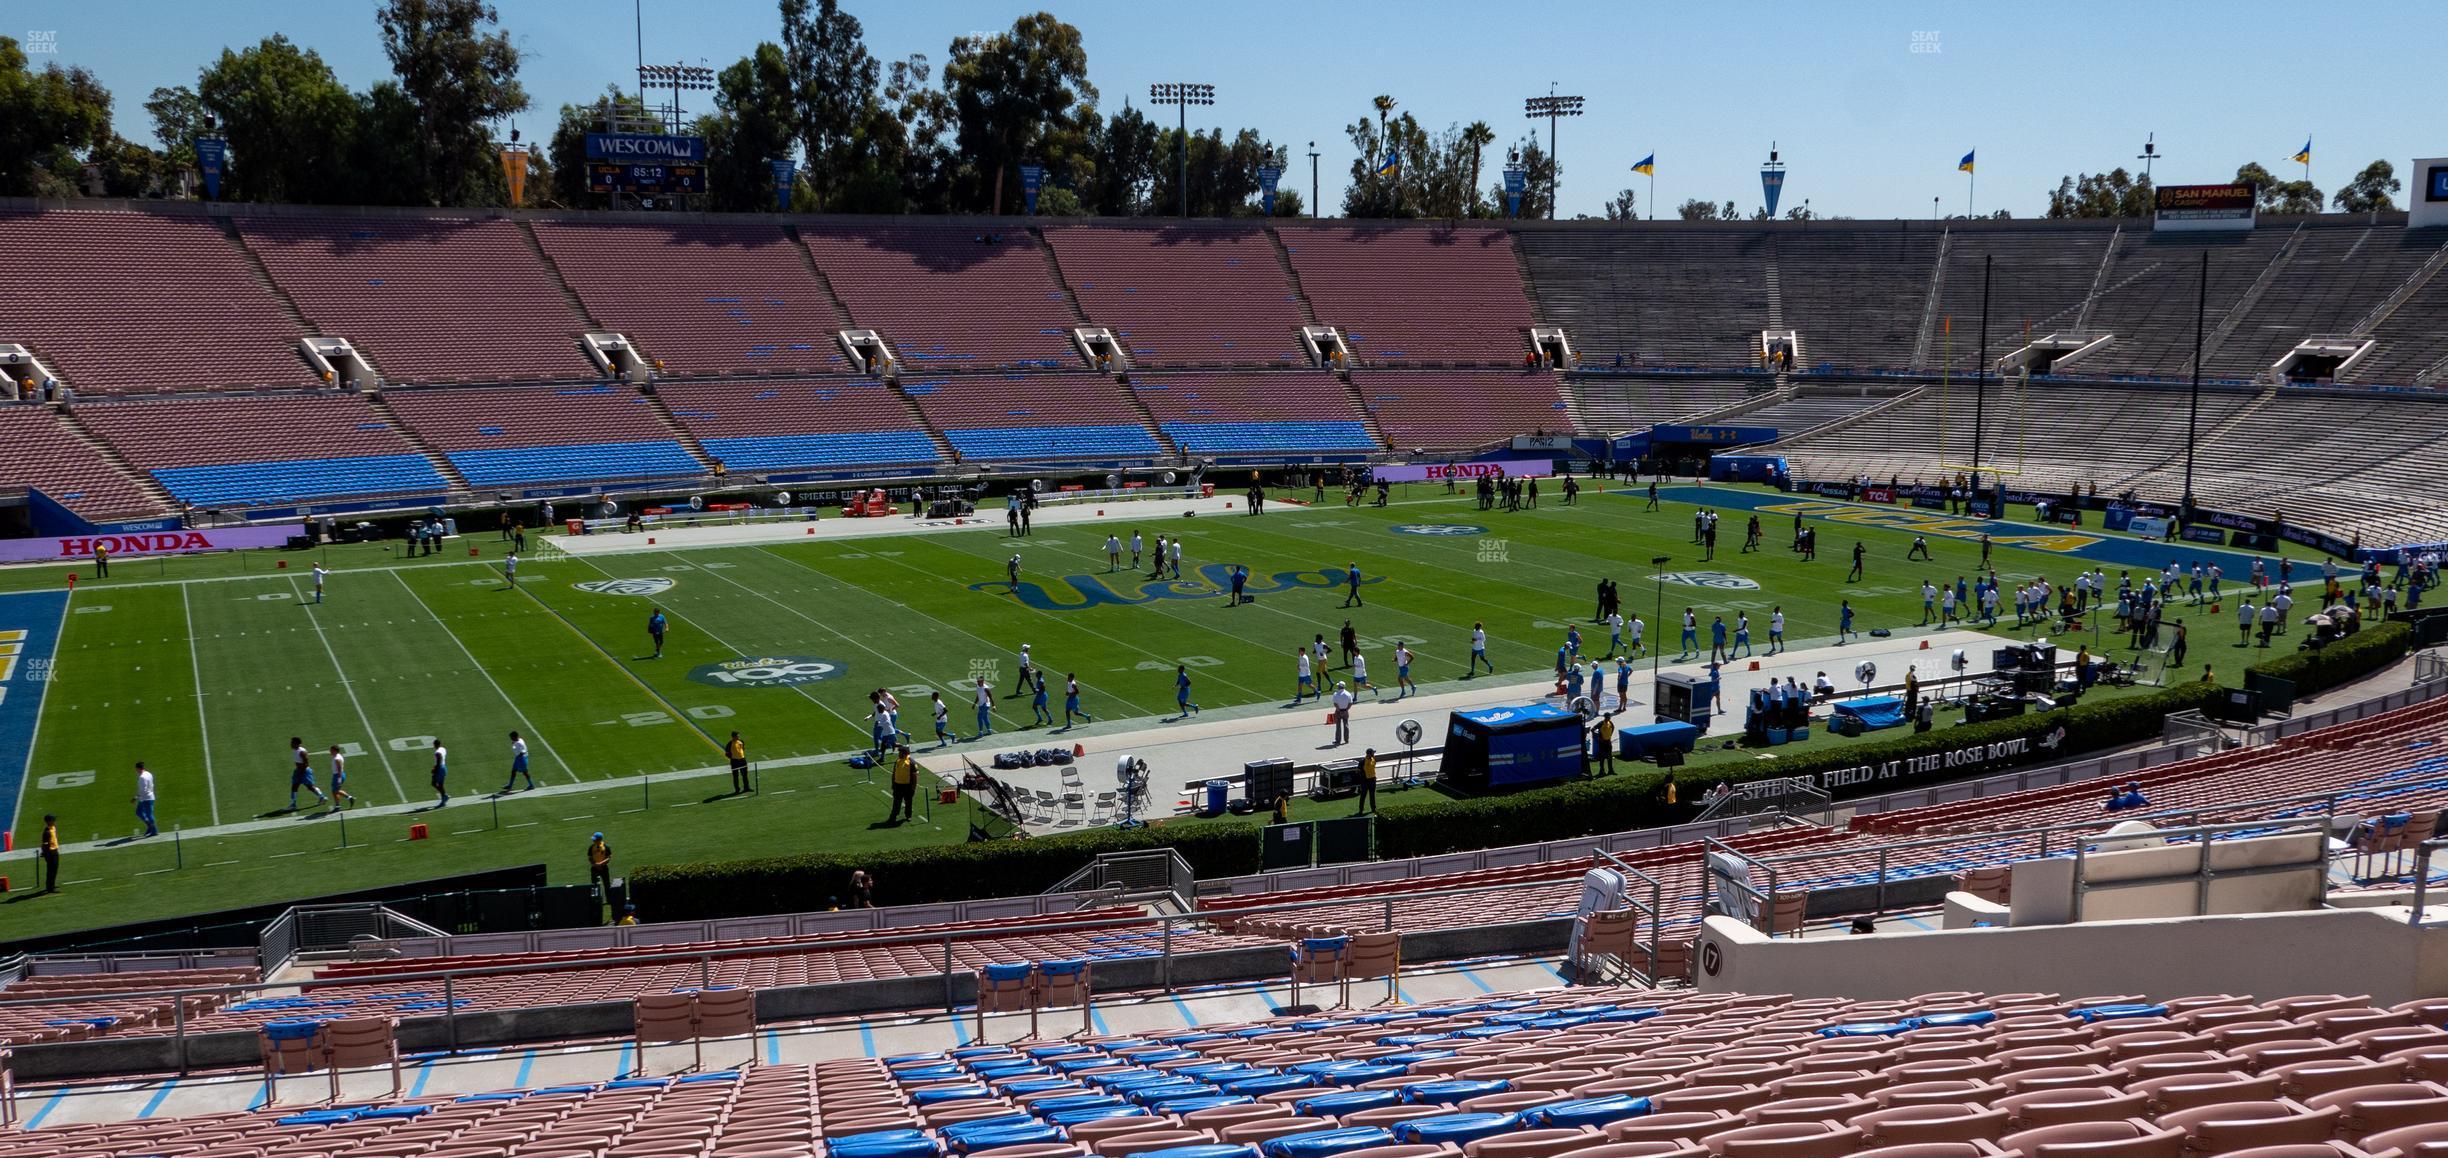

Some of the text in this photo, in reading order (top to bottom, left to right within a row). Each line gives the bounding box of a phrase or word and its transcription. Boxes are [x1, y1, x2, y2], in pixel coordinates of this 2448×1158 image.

[600, 138, 672, 154] WESCOM
[605, 174, 612, 184] 0
[633, 168, 662, 177] 85:12
[683, 177, 690, 186] 0
[2175, 187, 2251, 199] SAN MANUEL
[1425, 464, 1502, 478] HONDA
[798, 491, 838, 501] SPIEKER
[889, 488, 908, 496] THE
[1868, 491, 1889, 501] TCL
[121, 523, 155, 532] WESCOM
[59, 532, 213, 556] HONDA
[966, 563, 1389, 611] Ucla
[1134, 655, 1226, 672] 40
[706, 663, 835, 683] 100
[744, 674, 824, 687] YEARS
[620, 705, 736, 727] 20
[1822, 765, 1874, 788] FIELD
[1878, 760, 1902, 779] AT
[1906, 754, 1940, 775] THE
[1944, 745, 1984, 767] ROSE
[1987, 737, 2029, 760] BOWL
[37, 769, 96, 789] G
[1705, 947, 1718, 969] 17
